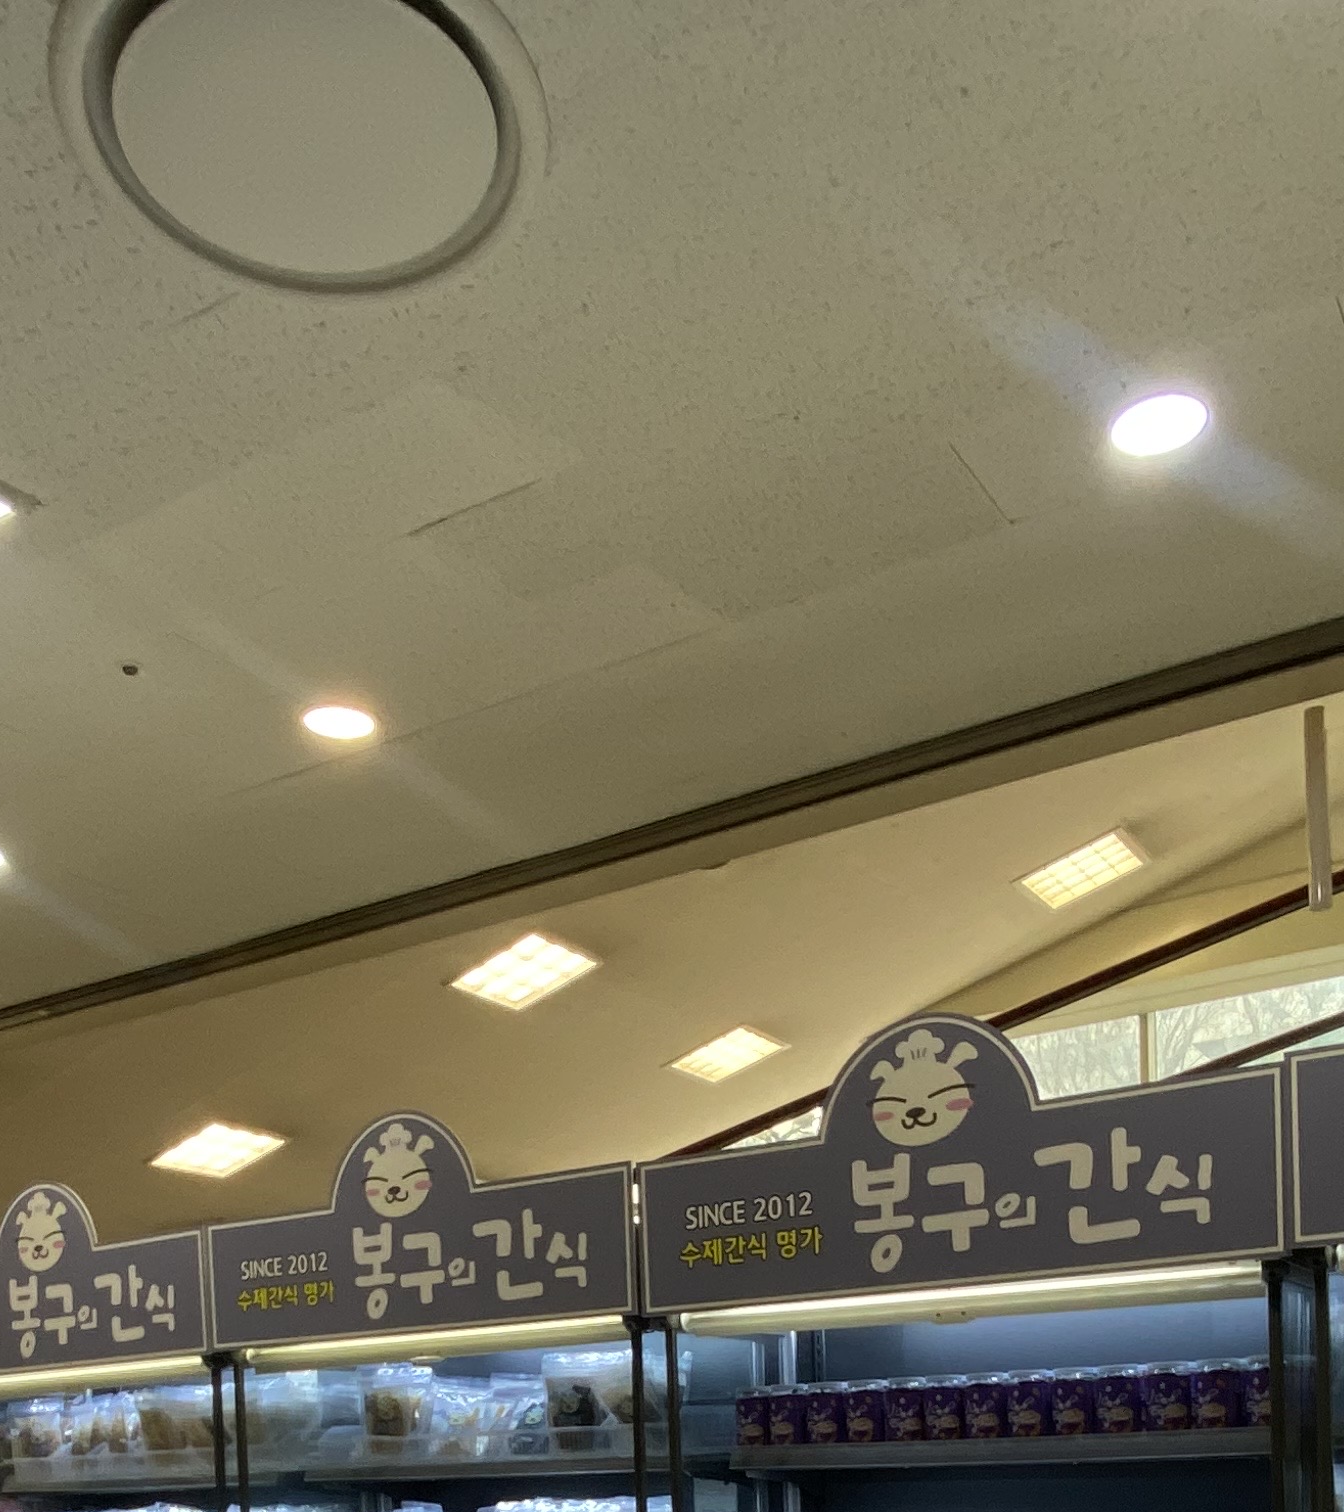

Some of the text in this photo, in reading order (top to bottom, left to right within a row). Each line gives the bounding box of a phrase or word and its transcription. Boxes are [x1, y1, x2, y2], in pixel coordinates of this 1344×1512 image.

[684, 1191, 814, 1230] SINCE 2012
[851, 1127, 1213, 1274] 봉구의 간식
[240, 1252, 328, 1281] SINCE 2012
[352, 1208, 587, 1320] 봉구의 간식
[679, 1226, 824, 1270] 수제간식 명가
[9, 1264, 176, 1359] 봉구의 간식
[237, 1281, 335, 1312] 수제간식 명가
